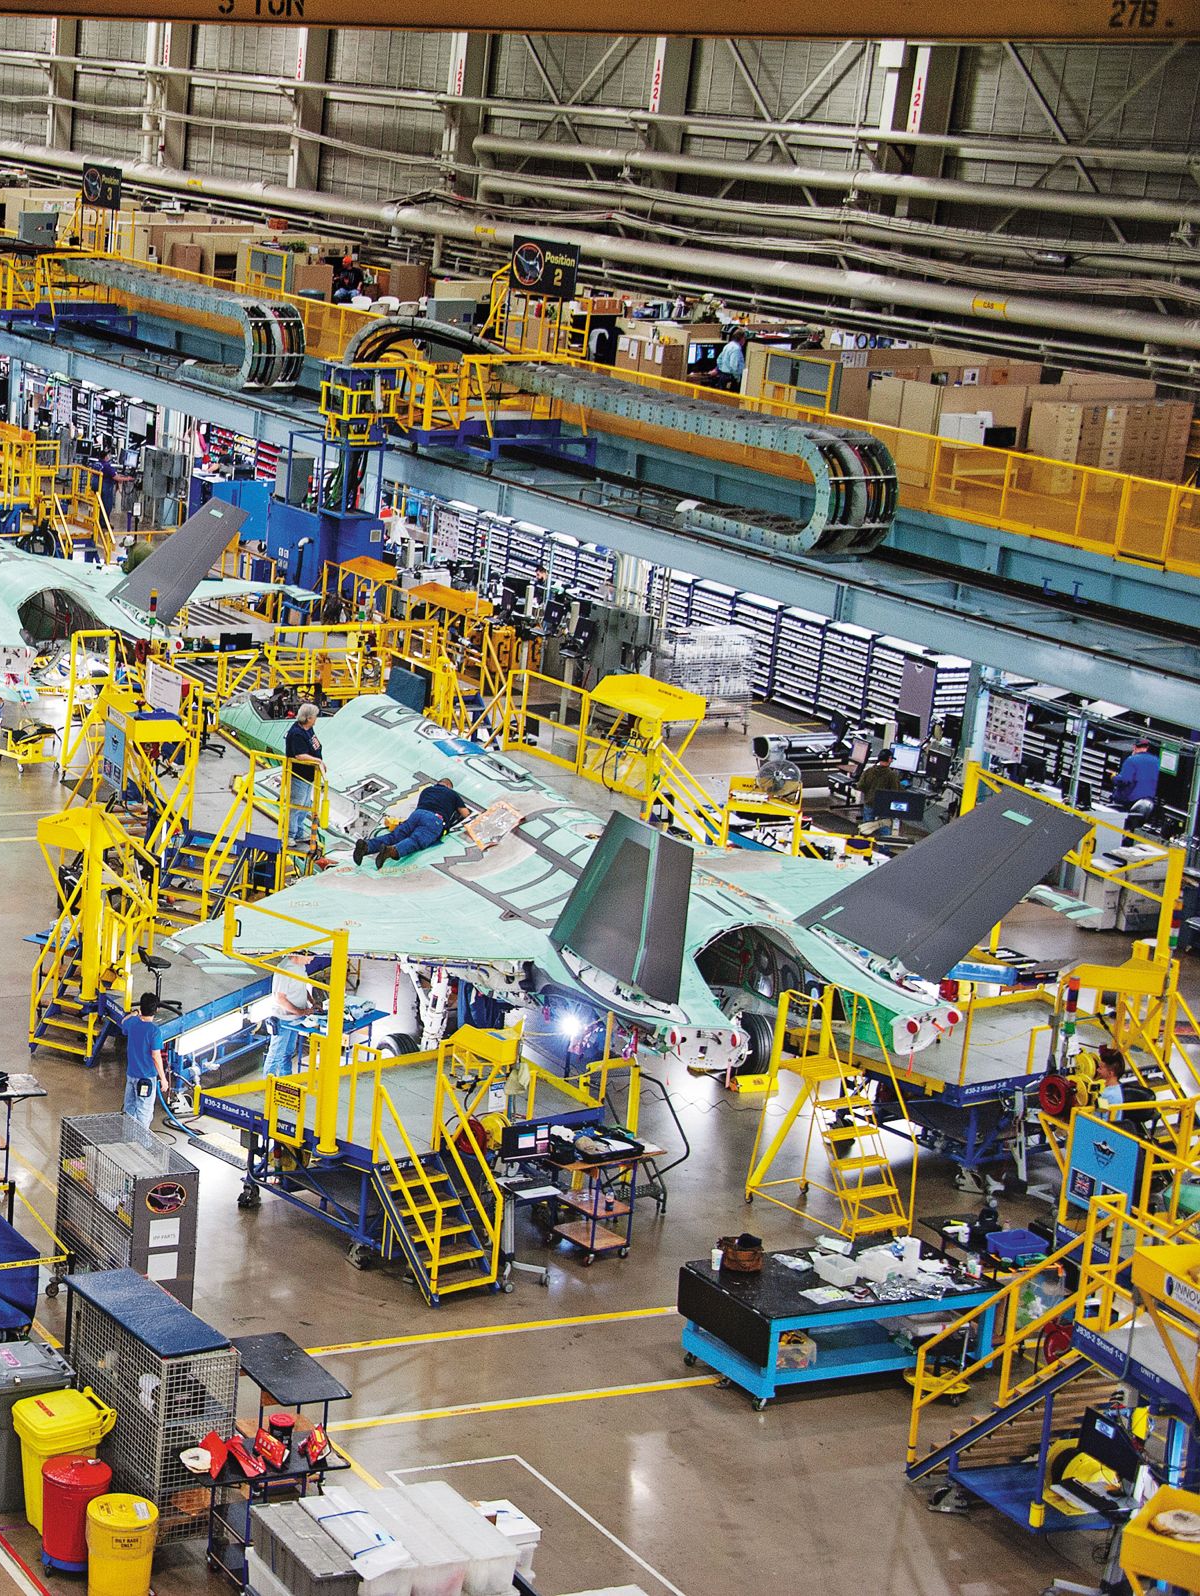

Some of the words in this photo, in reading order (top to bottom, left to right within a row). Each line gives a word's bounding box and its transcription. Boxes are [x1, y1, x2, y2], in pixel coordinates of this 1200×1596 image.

[545, 250, 576, 268] Position
[553, 268, 563, 287] 2
[222, 1103, 240, 1115] Stand
[1096, 1337, 1114, 1354] Stand
